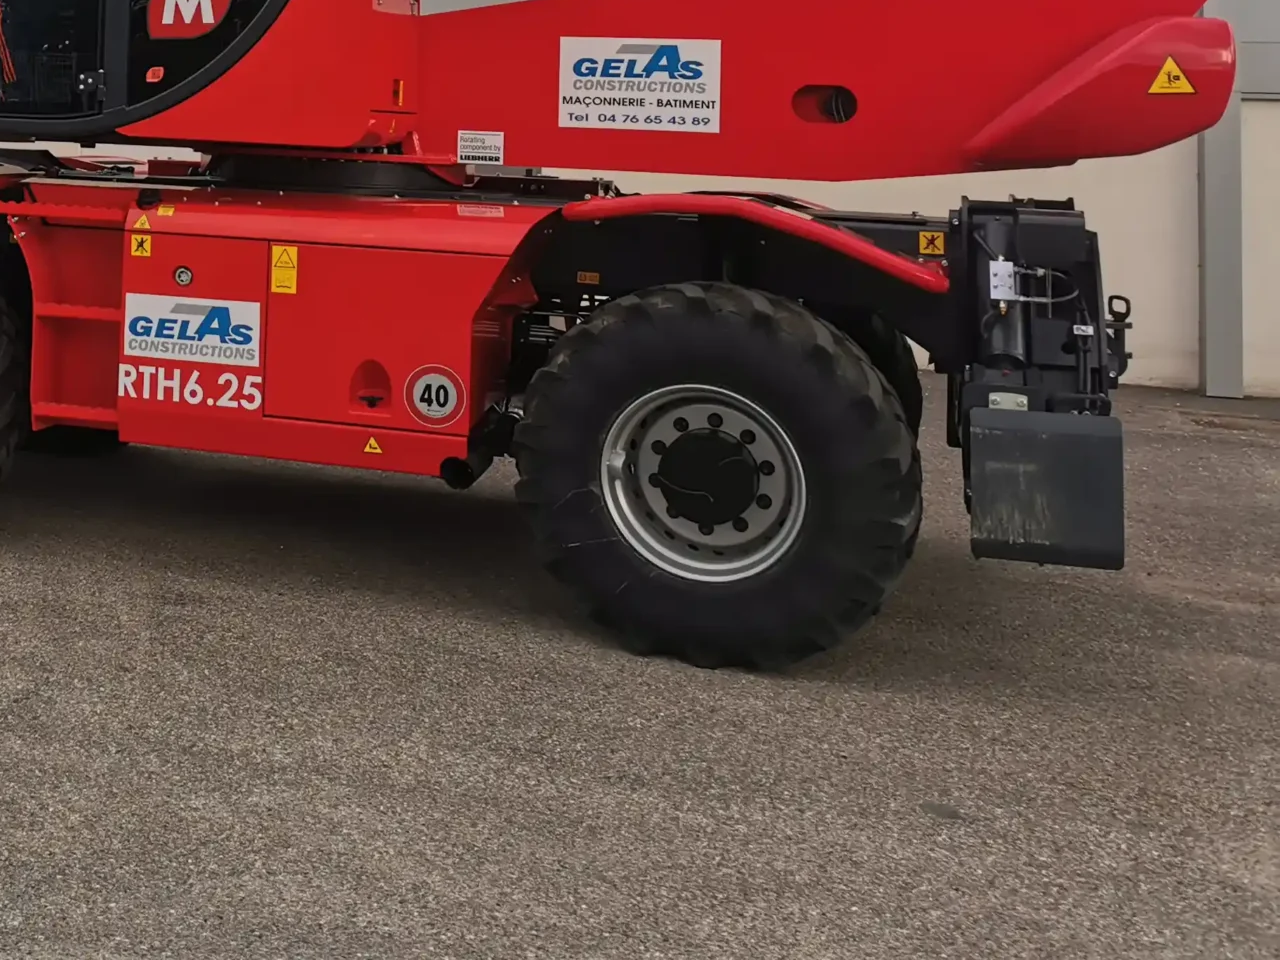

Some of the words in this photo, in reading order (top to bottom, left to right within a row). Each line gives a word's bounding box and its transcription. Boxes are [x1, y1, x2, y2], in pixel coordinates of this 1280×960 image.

[572, 45, 704, 80] GELAS
[573, 79, 707, 94] CONSTRUCTIONS
[562, 96, 646, 108] MAÇONNERIE
[656, 98, 717, 110] BATIMENT
[568, 112, 589, 122] Tel
[598, 113, 616, 123] 04
[622, 114, 639, 124] 76
[644, 115, 662, 124] 65
[667, 116, 686, 125] 43
[691, 117, 711, 126] 89
[128, 306, 254, 345] GELAS
[128, 338, 256, 361] CONSTRUCTIONS
[117, 363, 262, 411] RTH6.25
[419, 383, 449, 408] 40
